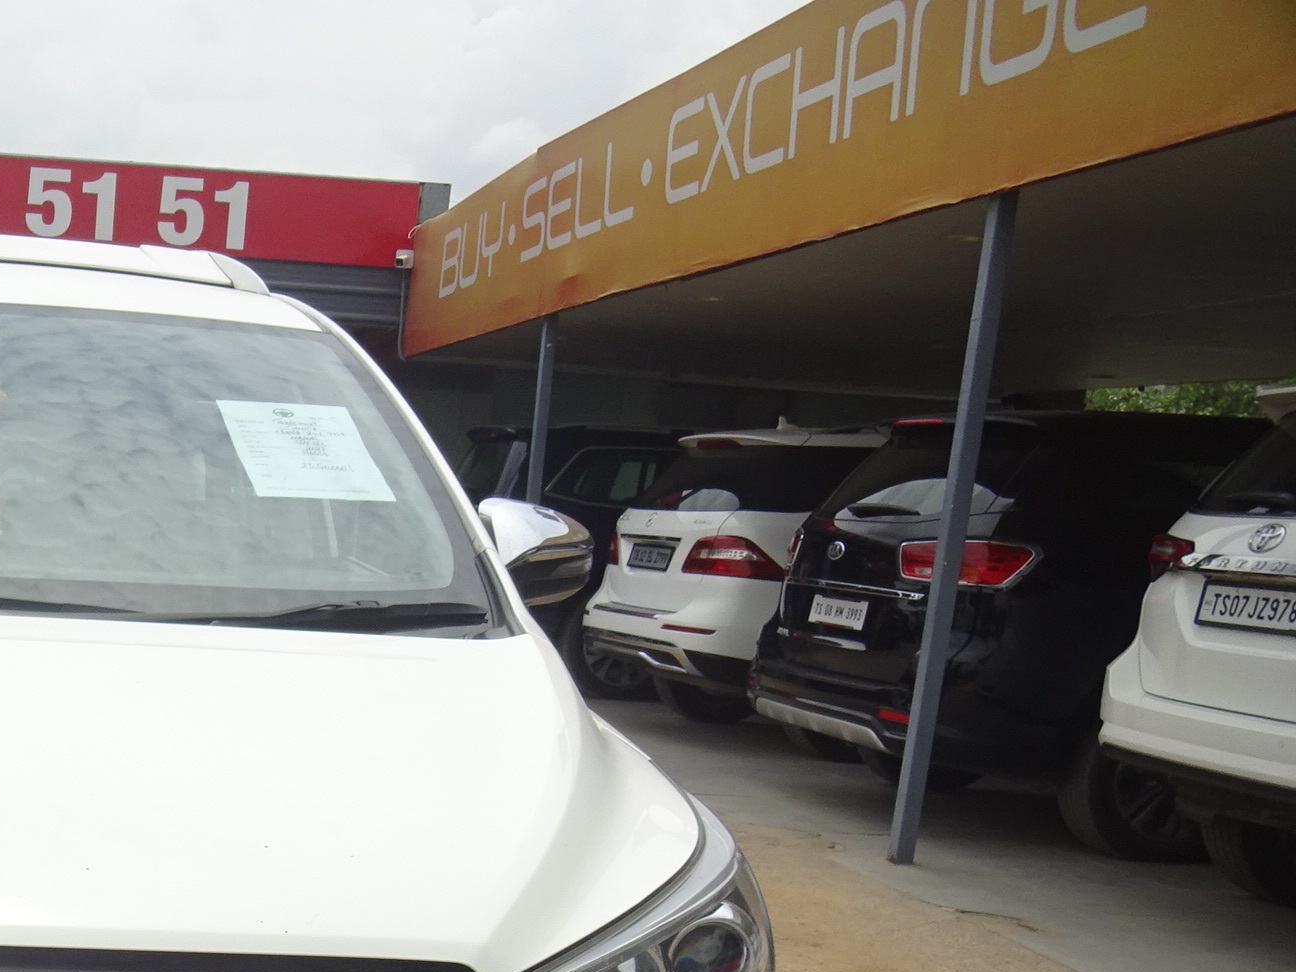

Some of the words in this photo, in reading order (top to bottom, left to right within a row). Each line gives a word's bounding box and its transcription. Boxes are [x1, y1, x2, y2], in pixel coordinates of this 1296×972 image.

[25, 166, 119, 242] 51
[156, 175, 251, 250] 51
[439, 200, 507, 298] BUY
[519, 142, 634, 263] SELL
[815, 602, 823, 615] TS
